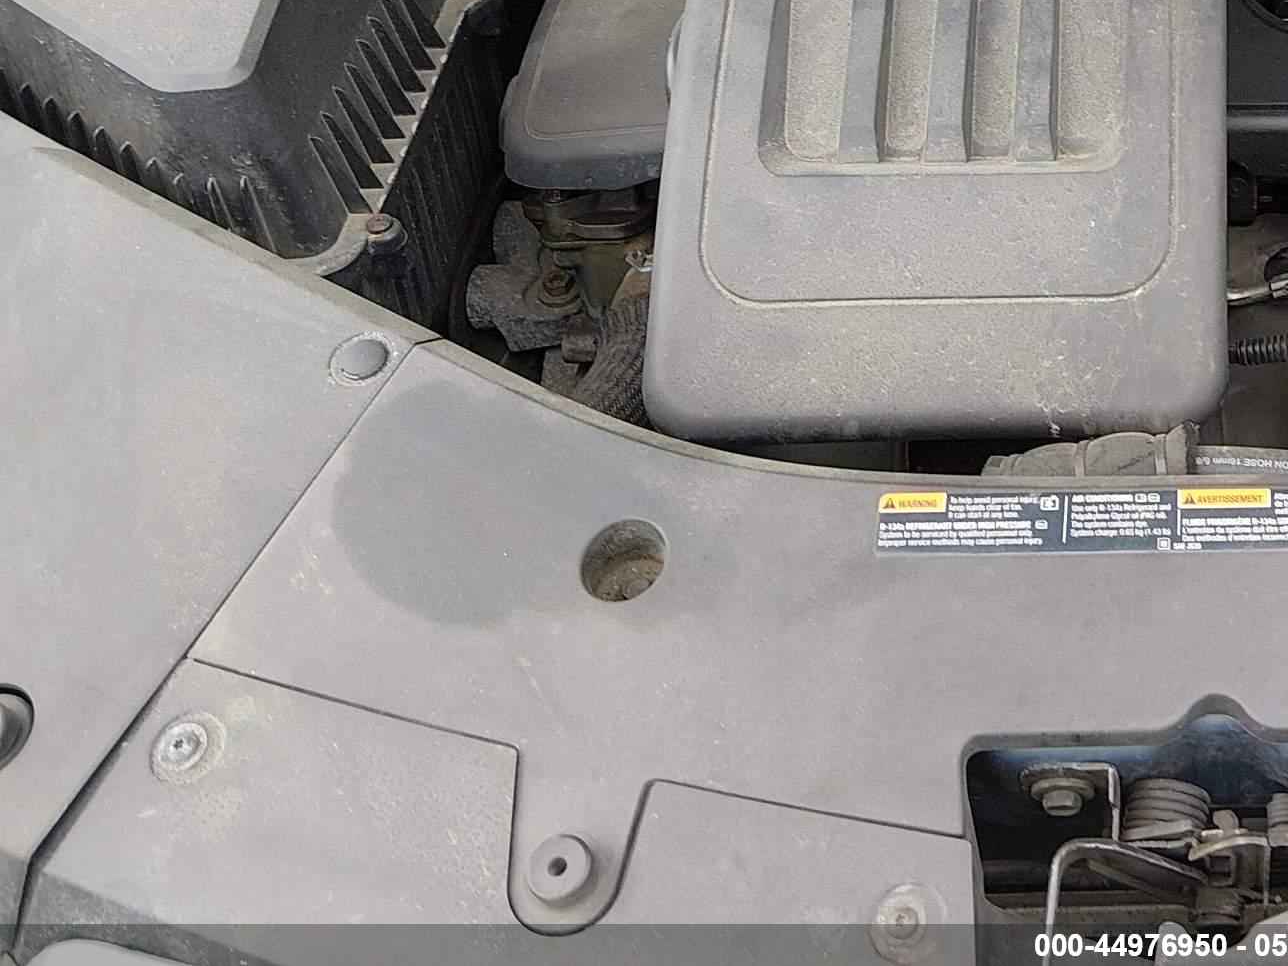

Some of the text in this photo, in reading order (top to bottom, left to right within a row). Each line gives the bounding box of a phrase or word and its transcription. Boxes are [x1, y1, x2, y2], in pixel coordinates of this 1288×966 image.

[1243, 458, 1273, 468] HOSE
[898, 499, 938, 508] WARNING
[1197, 494, 1264, 504] AVERTISSEMENT
